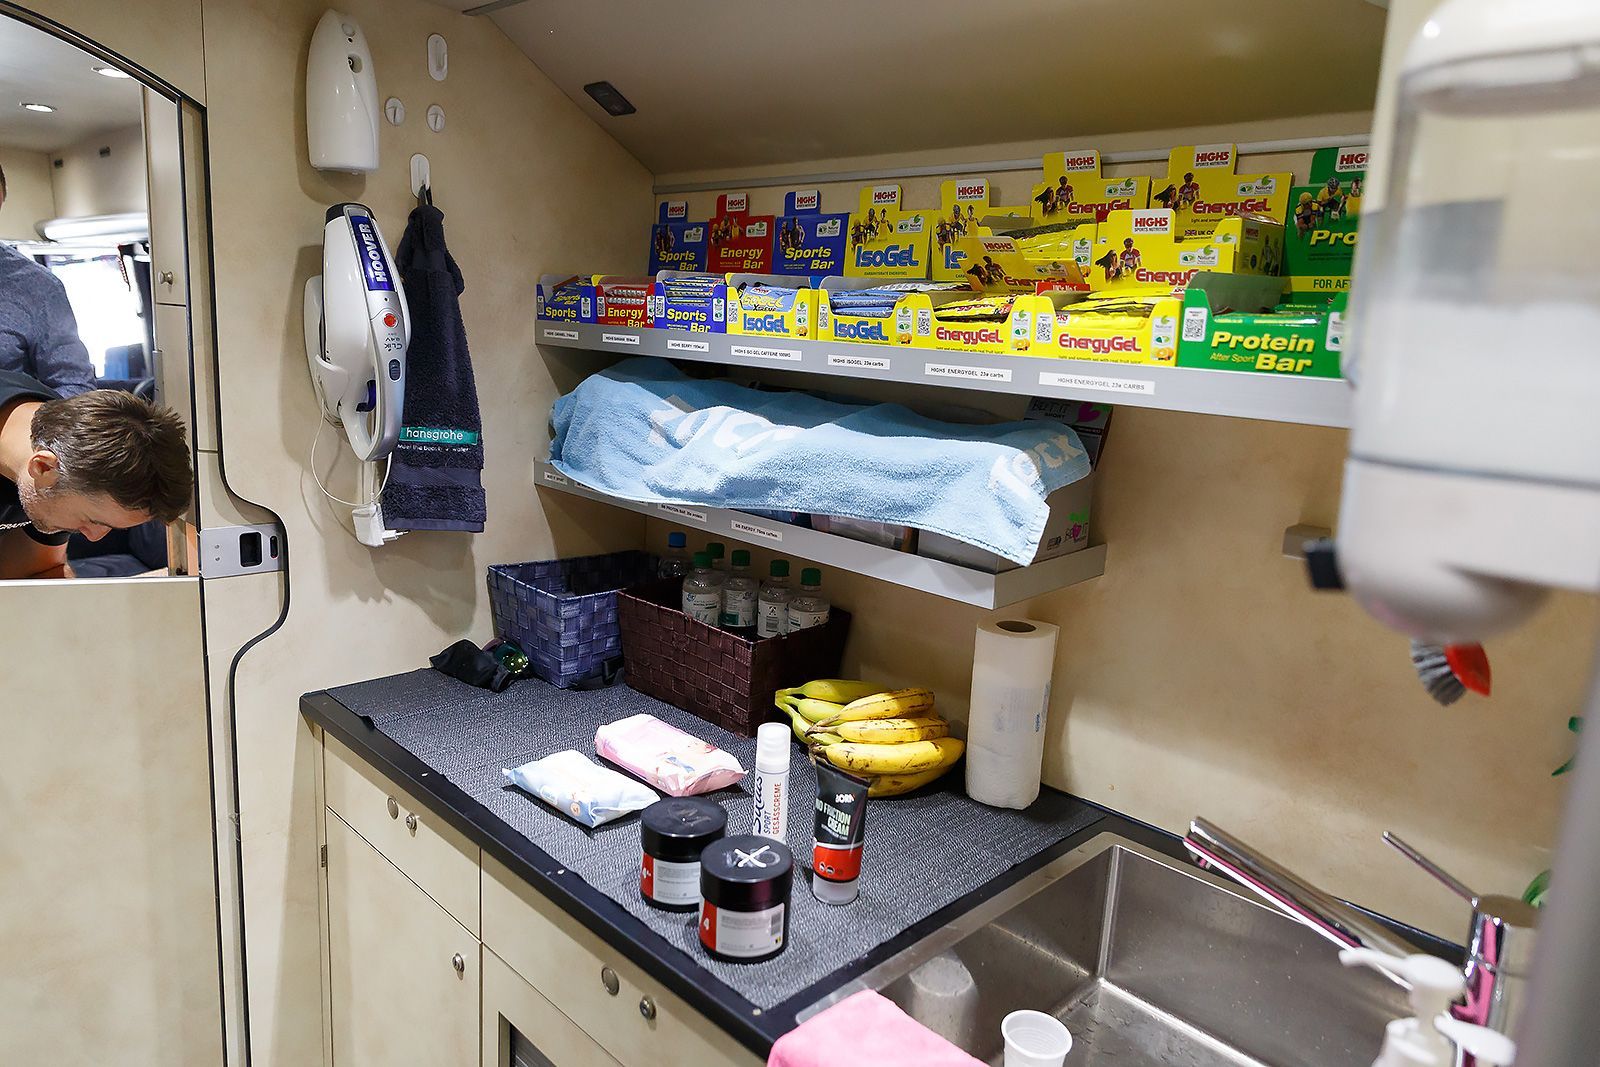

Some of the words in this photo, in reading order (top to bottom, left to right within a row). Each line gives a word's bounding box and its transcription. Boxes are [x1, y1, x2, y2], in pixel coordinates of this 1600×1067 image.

[1066, 156, 1095, 167] HIGH5
[1195, 152, 1229, 162] HIGH5
[874, 191, 897, 200] HIGH5
[958, 186, 984, 196] HIGH5
[1134, 217, 1169, 228] HIGH5
[358, 223, 388, 283] HOOVER
[658, 250, 696, 263] Sports
[720, 247, 764, 260] Energy
[784, 246, 832, 261] Sports
[679, 262, 698, 272] Bar
[742, 260, 764, 270] Bar
[810, 259, 835, 271] Bar
[1314, 279, 1332, 289] FOR
[545, 306, 577, 318] Sports
[608, 308, 644, 319] Energy
[666, 308, 708, 322] Sports
[690, 322, 711, 333] Bar
[1211, 331, 1315, 353] Protein
[1255, 353, 1313, 373] Bar
[948, 368, 978, 376] ENERGYGEL
[1074, 378, 1110, 388] ENERGYGEL
[406, 427, 463, 440] hansgrohe
[824, 802, 852, 826] FRICTION
[764, 810, 772, 834] SPORT
[828, 816, 850, 836] CREAM
